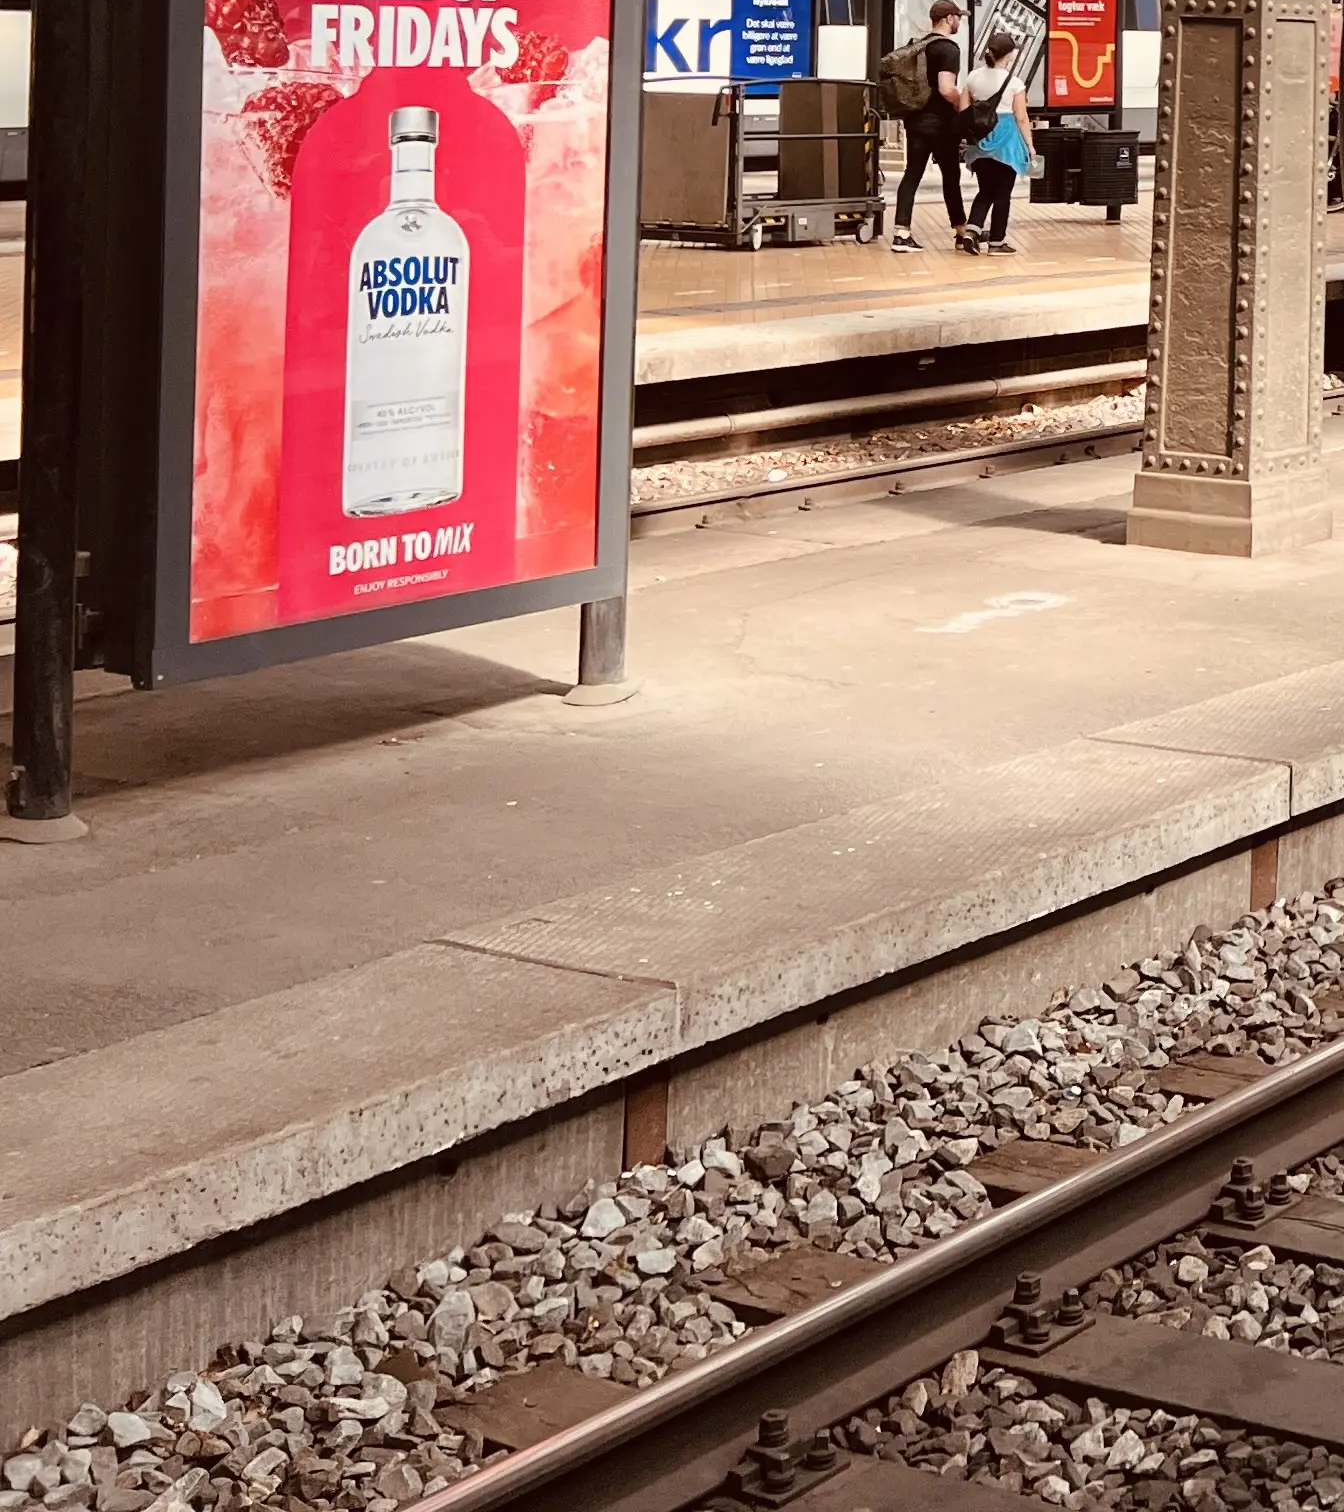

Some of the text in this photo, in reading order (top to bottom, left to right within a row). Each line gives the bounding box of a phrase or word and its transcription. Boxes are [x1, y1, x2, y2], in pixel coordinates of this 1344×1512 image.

[311, 4, 520, 68] FRIDAYS
[746, 17, 760, 28] Det
[359, 256, 460, 292] ABSOLUT
[367, 286, 450, 320] VODKA
[329, 522, 475, 576] BORN TO MIX
[354, 569, 451, 596] ENJOY RESPONSIBLY
